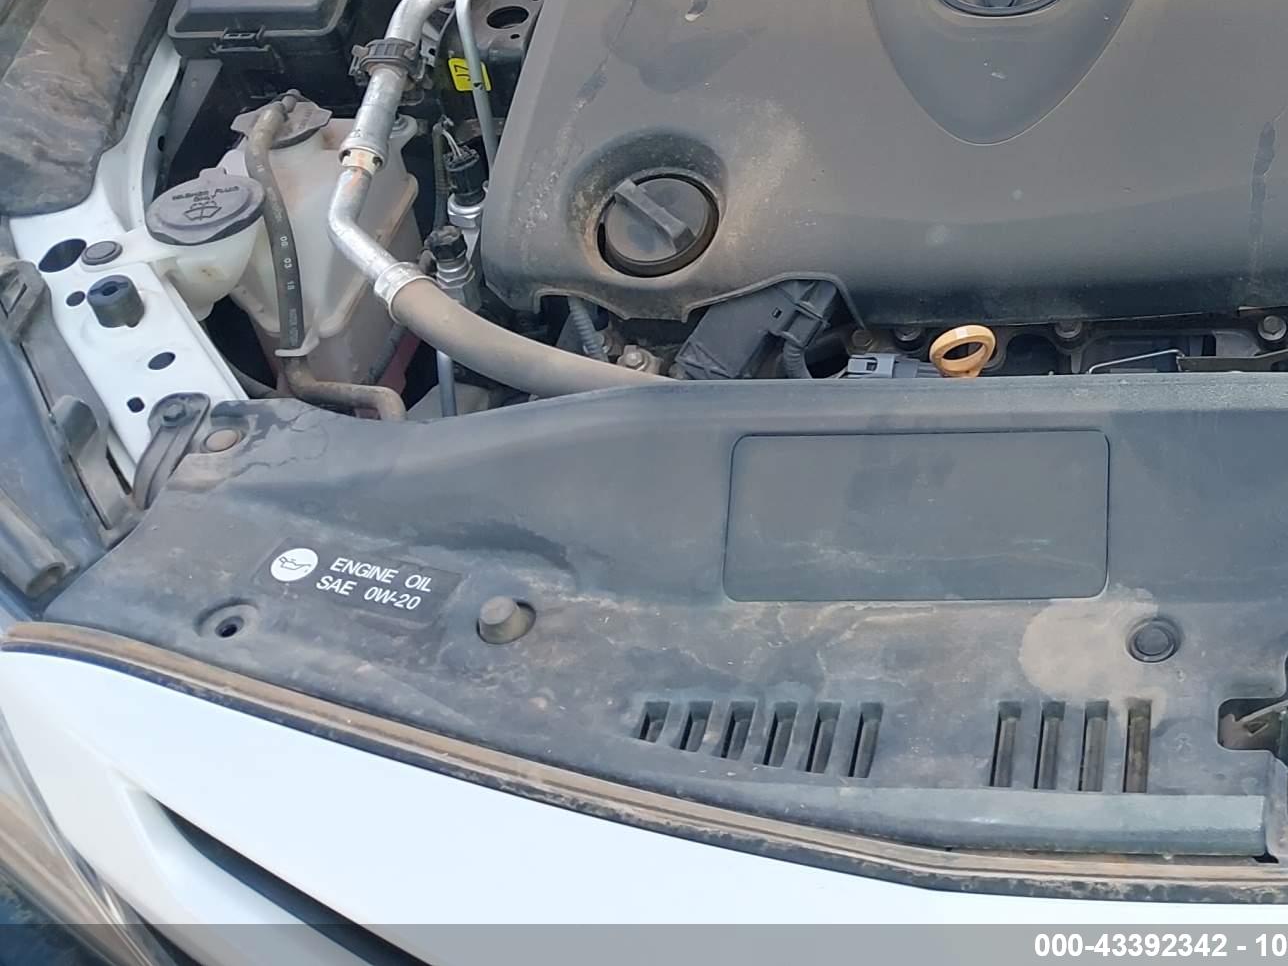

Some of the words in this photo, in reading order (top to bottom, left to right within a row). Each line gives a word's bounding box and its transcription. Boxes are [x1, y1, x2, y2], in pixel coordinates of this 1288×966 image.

[330, 558, 399, 583] ENGINE
[405, 575, 432, 592] OIL
[316, 575, 357, 595] SAE
[364, 587, 421, 610] 0W-20
